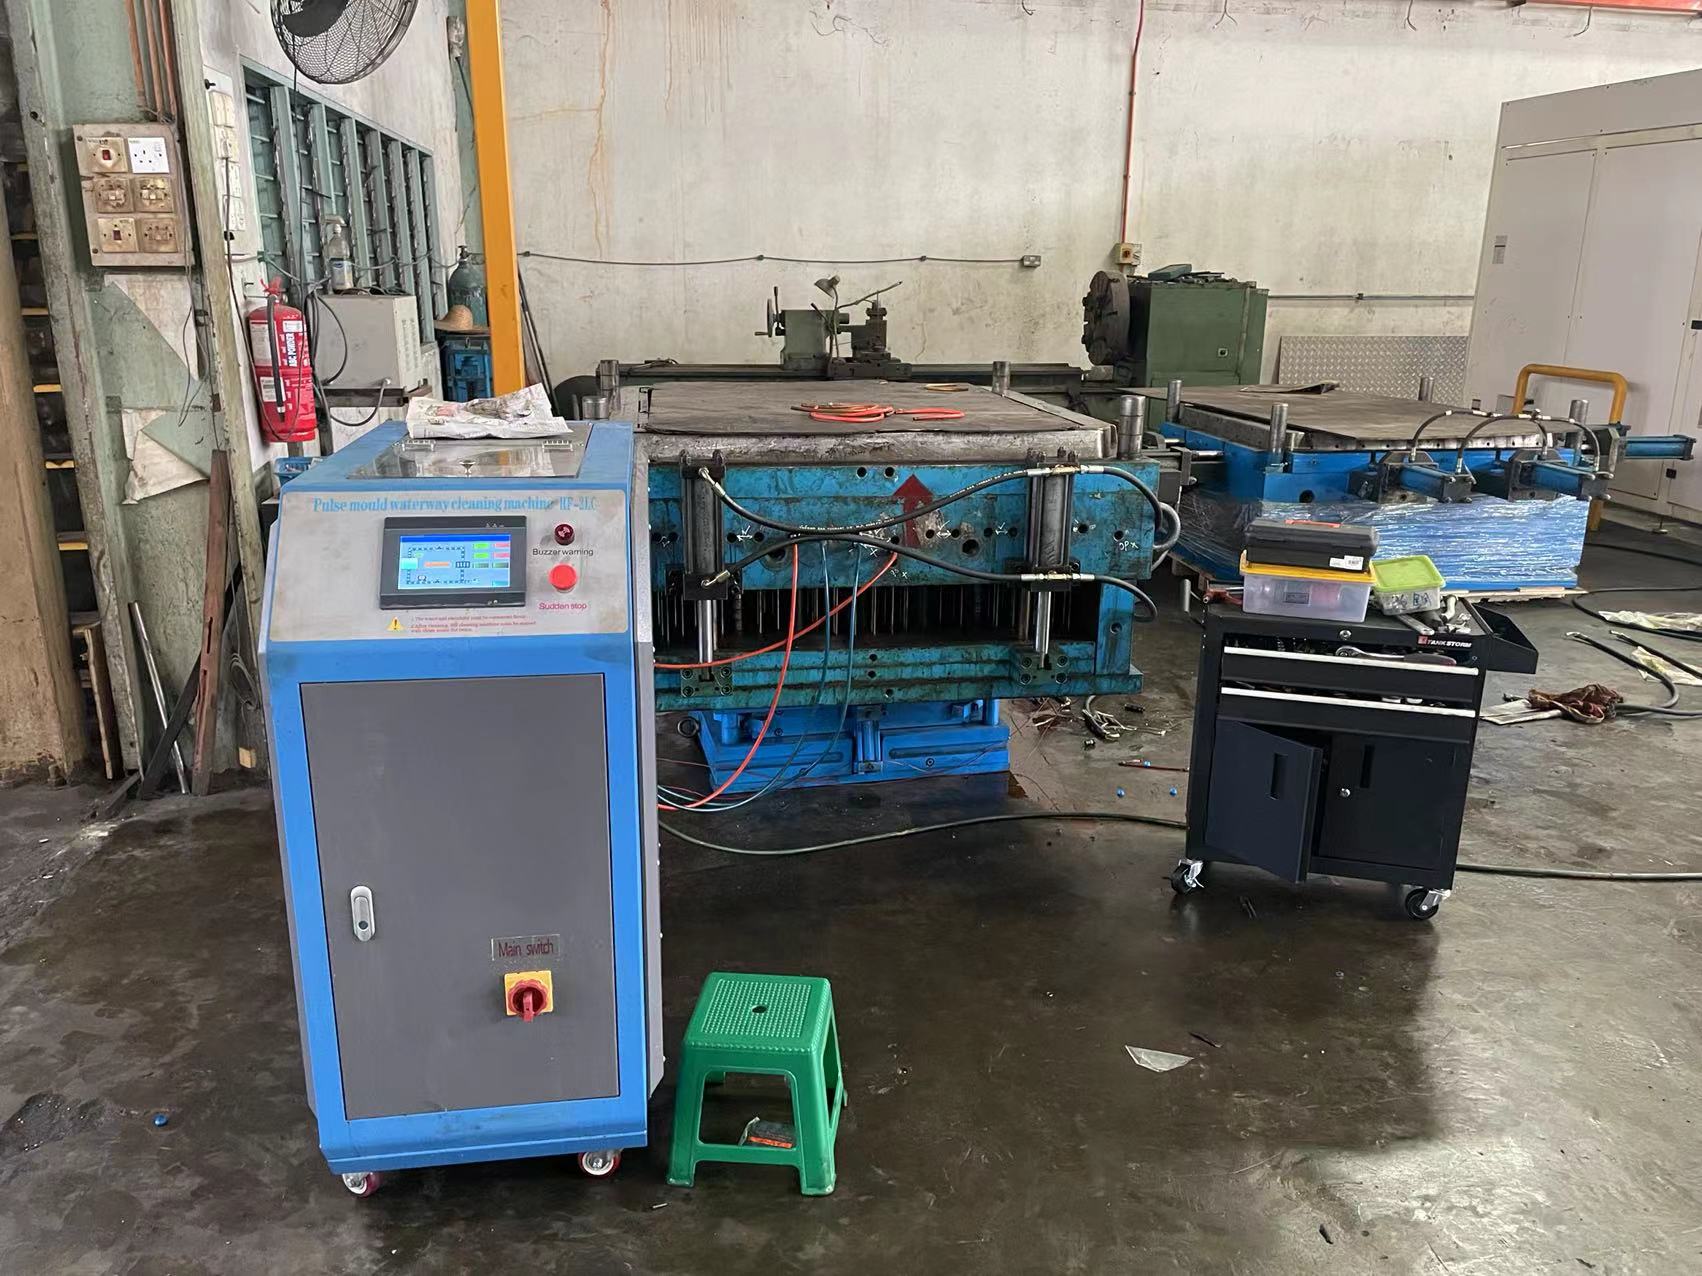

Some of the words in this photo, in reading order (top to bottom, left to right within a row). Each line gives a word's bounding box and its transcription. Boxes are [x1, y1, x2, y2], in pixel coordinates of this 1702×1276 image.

[286, 332, 297, 356] POWDER
[313, 496, 347, 512] Pulse
[350, 497, 387, 512] mould
[390, 498, 448, 513] waterway
[451, 496, 501, 512] cleaning
[532, 548, 561, 556] Buzzer
[561, 548, 594, 557] warning
[539, 602, 570, 610] Sudden
[570, 602, 587, 611] stop
[498, 941, 522, 958] Main
[526, 938, 554, 956] switch
